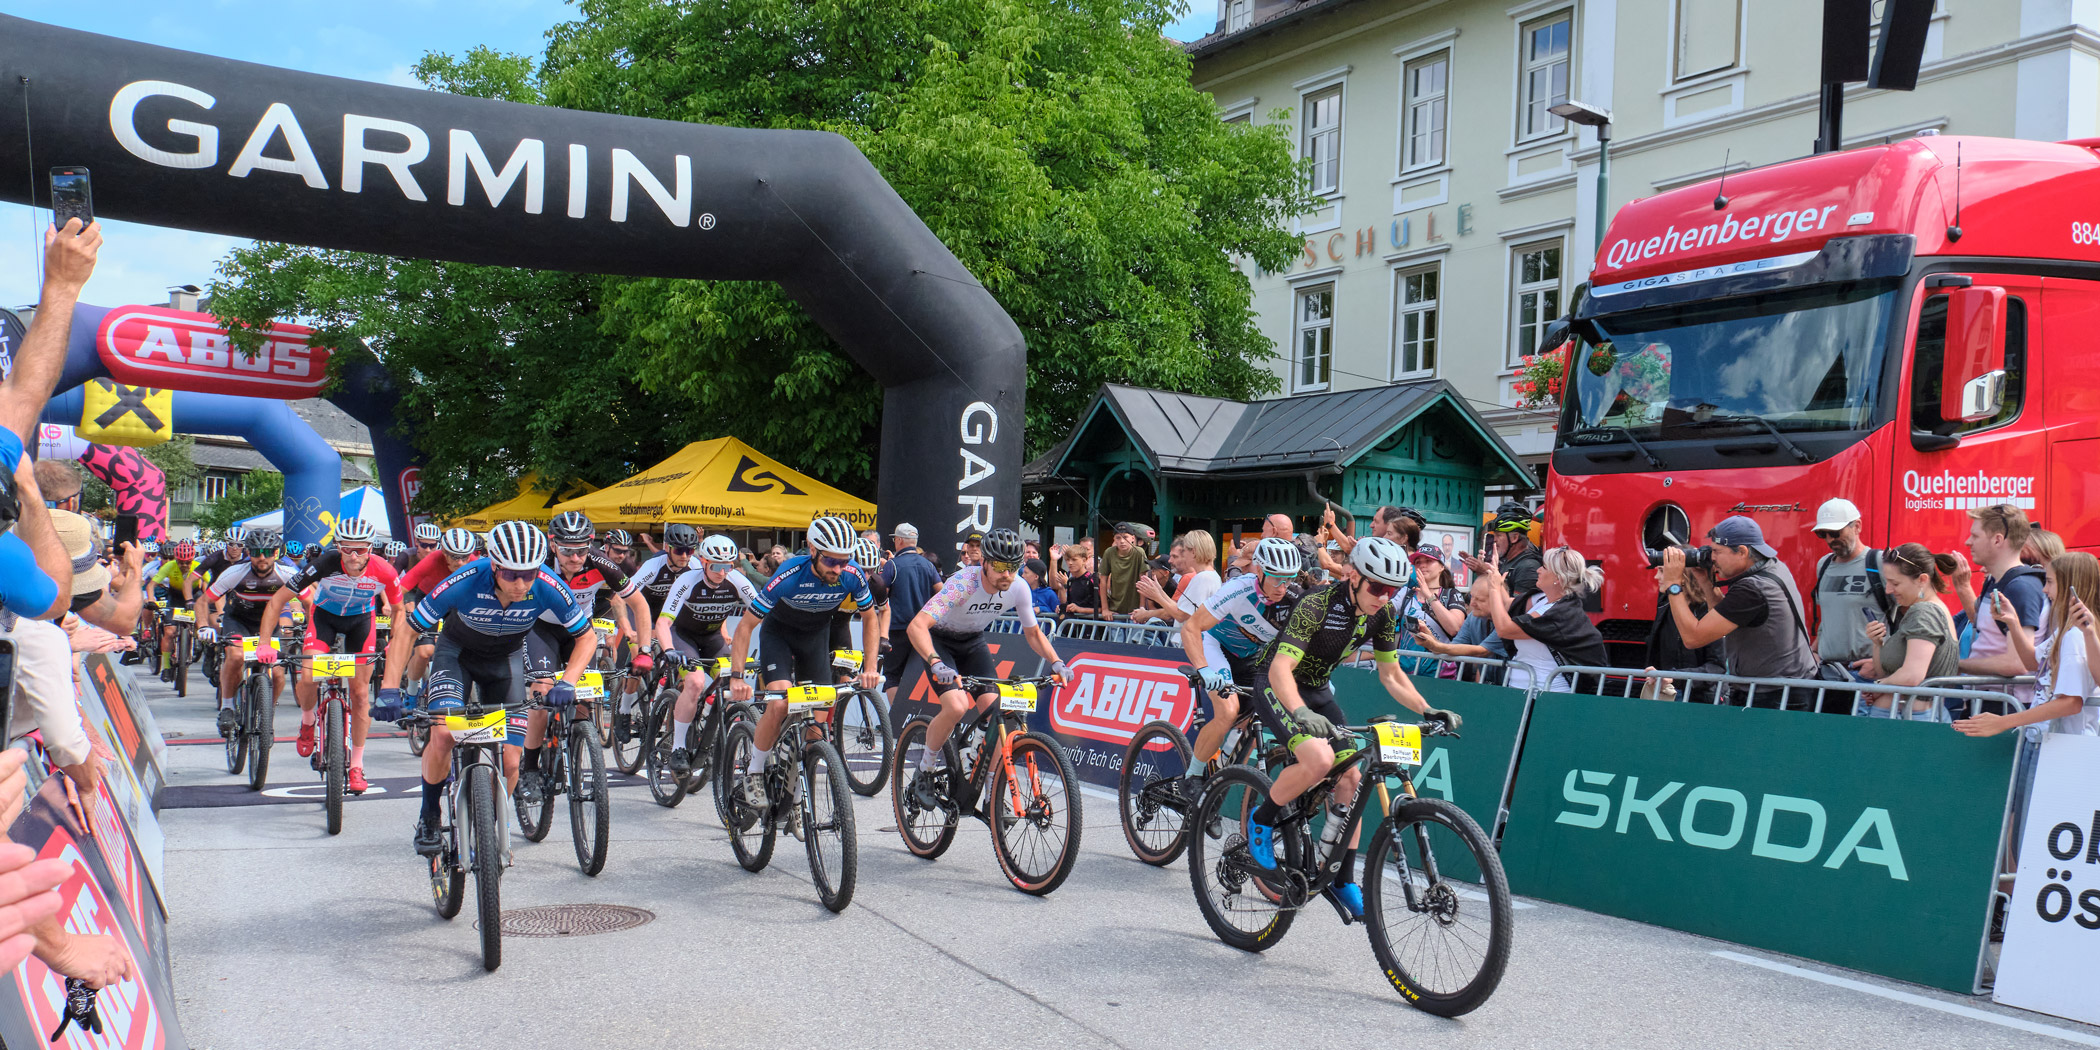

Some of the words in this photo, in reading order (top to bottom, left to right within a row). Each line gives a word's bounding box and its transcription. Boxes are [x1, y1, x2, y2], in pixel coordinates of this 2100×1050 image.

[109, 80, 692, 228] GARMIN
[1304, 202, 1473, 267] SCHULE
[1606, 205, 1838, 269] Quehenberger
[2072, 221, 2100, 245] 884
[135, 324, 311, 377] ABUS
[956, 401, 999, 550] GAR
[1903, 469, 2035, 499] Quehenberger
[619, 502, 664, 518] salzkammergut
[671, 503, 746, 518] www.trophy.at
[1905, 496, 1943, 512] logistics
[469, 607, 536, 617] GIANT
[968, 602, 1003, 611] nora
[327, 661, 340, 671] E3
[803, 686, 818, 695] E1
[1064, 672, 1179, 726] ABUS
[1389, 725, 1405, 739] E7
[1086, 748, 1108, 767] Tech
[1109, 753, 1154, 781] Geany
[1387, 969, 1420, 1001] MAXXIS
